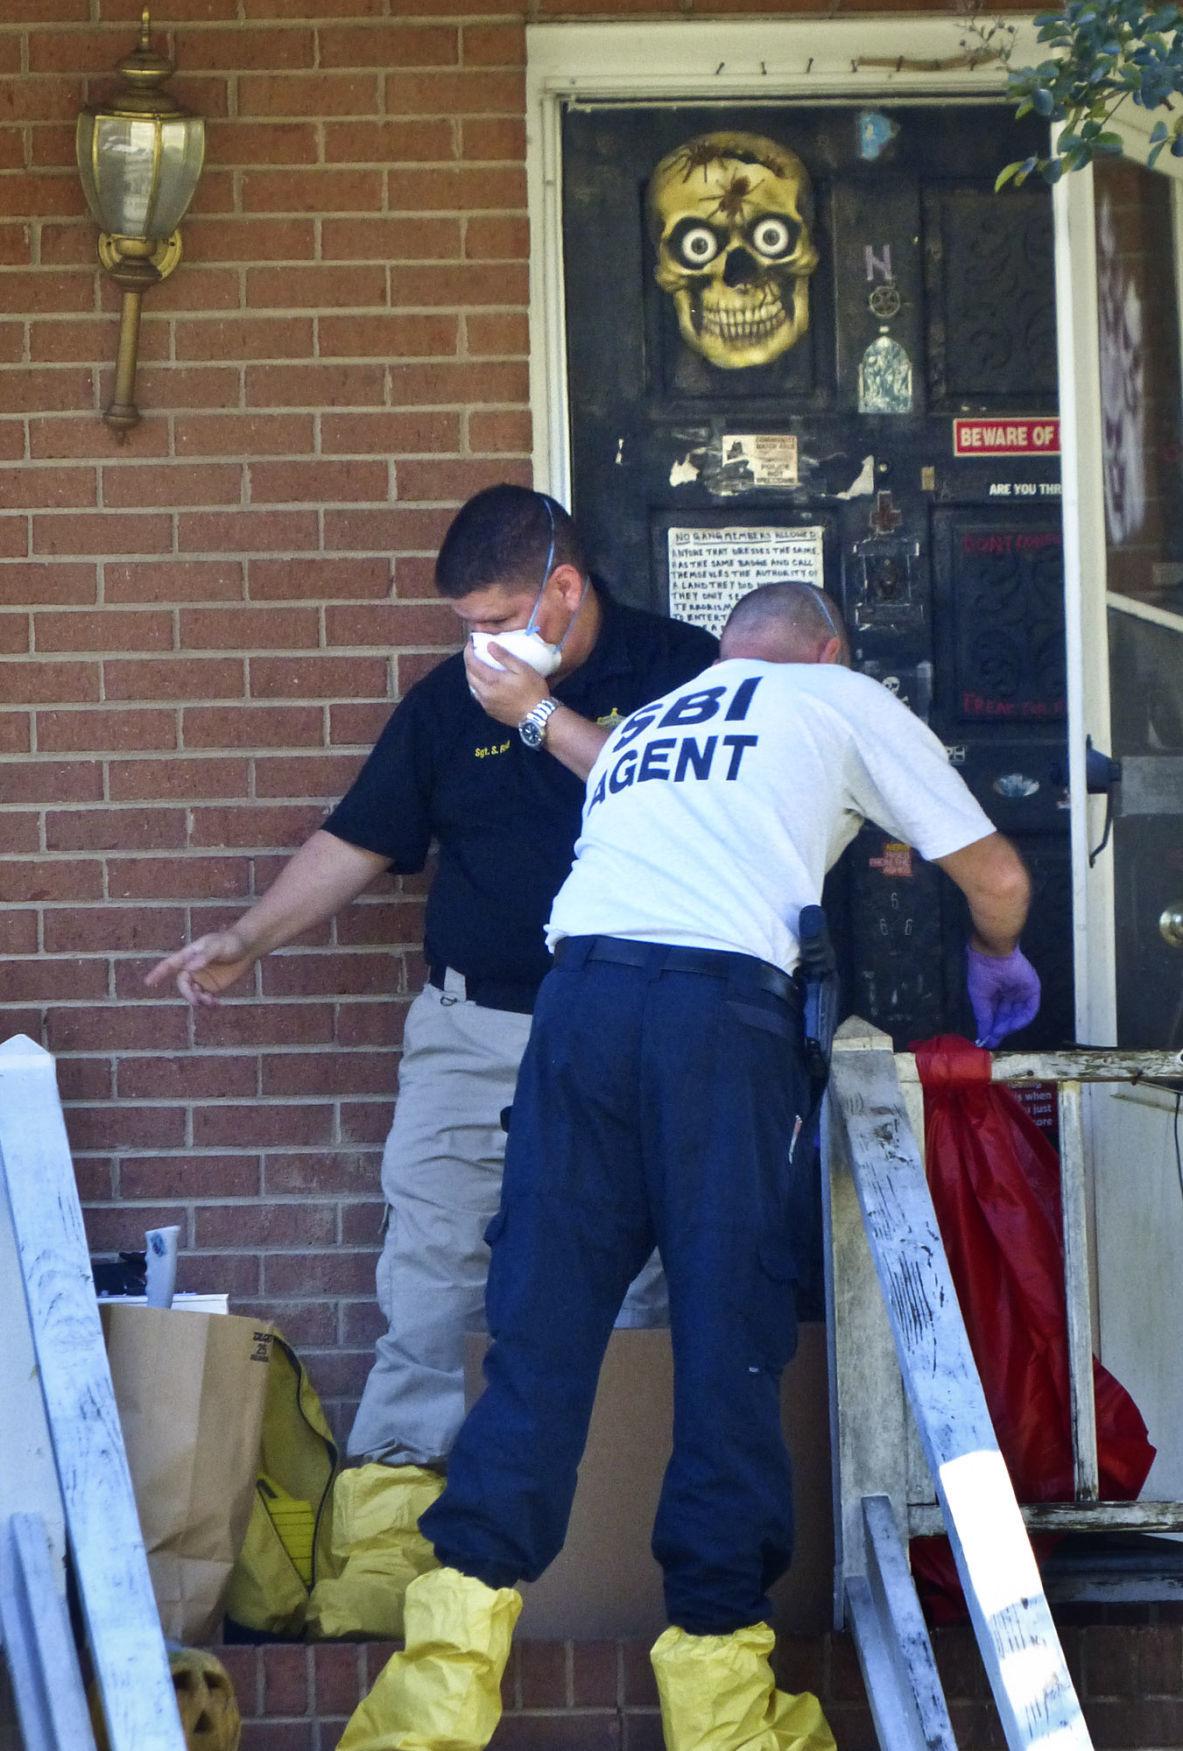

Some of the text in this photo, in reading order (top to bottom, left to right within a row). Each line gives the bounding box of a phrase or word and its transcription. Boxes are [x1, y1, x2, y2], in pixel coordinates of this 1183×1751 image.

[960, 426, 1055, 447] BEWARE OF
[989, 483, 1011, 495] ARE
[1013, 483, 1037, 495] YOU
[675, 532, 690, 541] NO
[775, 531, 816, 539] ALLOWED
[706, 548, 728, 556] THAT
[773, 547, 790, 555] THE
[689, 560, 707, 568] THE
[711, 560, 735, 568] SAME
[771, 559, 789, 567] AND
[755, 569, 807, 577] AUTHORITY
[709, 581, 735, 589] THEY
[672, 592, 698, 600] THEY
[612, 676, 764, 753] SBI
[587, 735, 759, 817] AGENT
[891, 892, 899, 909] 6
[880, 918, 889, 935] 6
[1024, 1091, 1052, 1100] when
[1033, 1104, 1052, 1114] just
